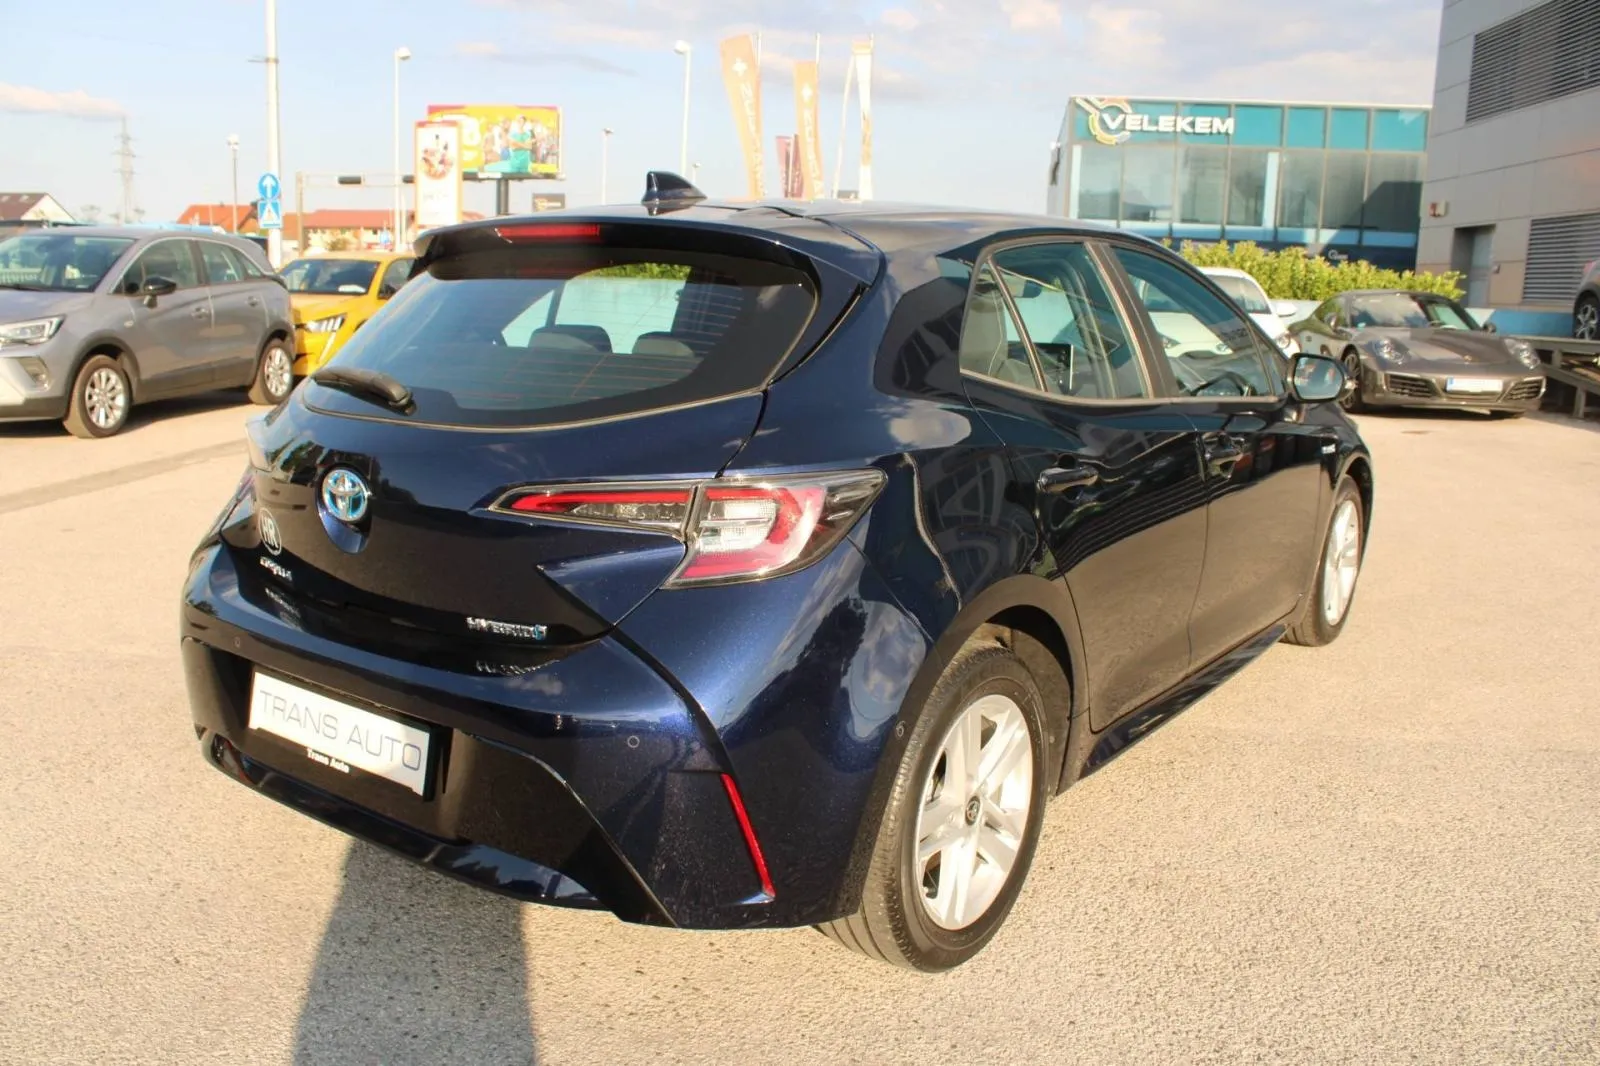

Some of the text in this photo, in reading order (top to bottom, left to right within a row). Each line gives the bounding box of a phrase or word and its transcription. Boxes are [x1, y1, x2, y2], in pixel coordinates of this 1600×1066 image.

[1102, 113, 1235, 134] VELEKEM
[260, 690, 422, 771] TRANS AUTO
